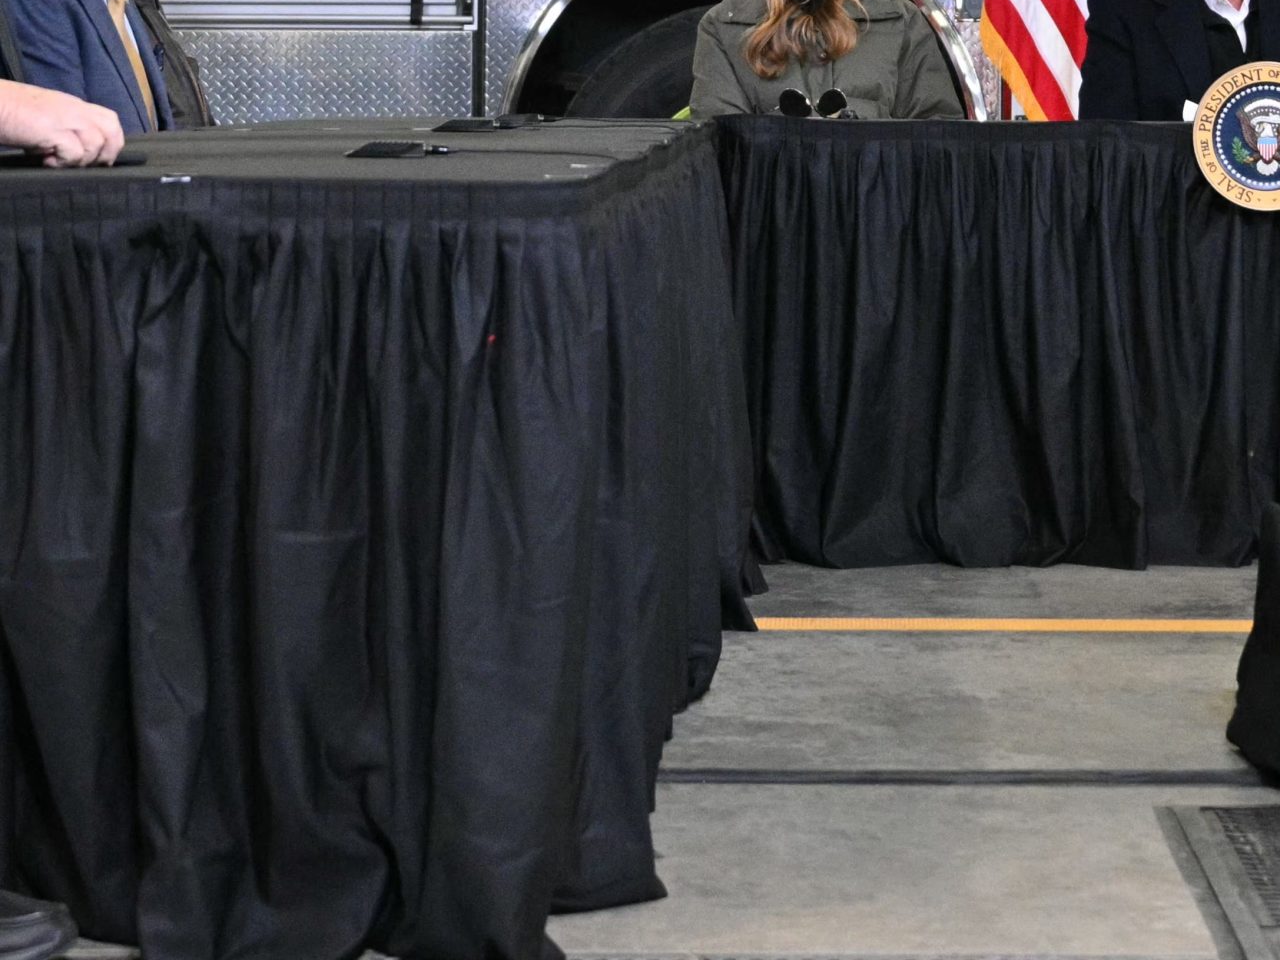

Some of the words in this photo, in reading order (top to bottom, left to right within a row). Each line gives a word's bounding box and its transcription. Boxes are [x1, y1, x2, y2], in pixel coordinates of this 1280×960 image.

[1199, 68, 1263, 133] PRESIDENT
[1200, 138, 1211, 159] THE
[1206, 161, 1218, 173] OF
[1217, 172, 1255, 204] SEAL
